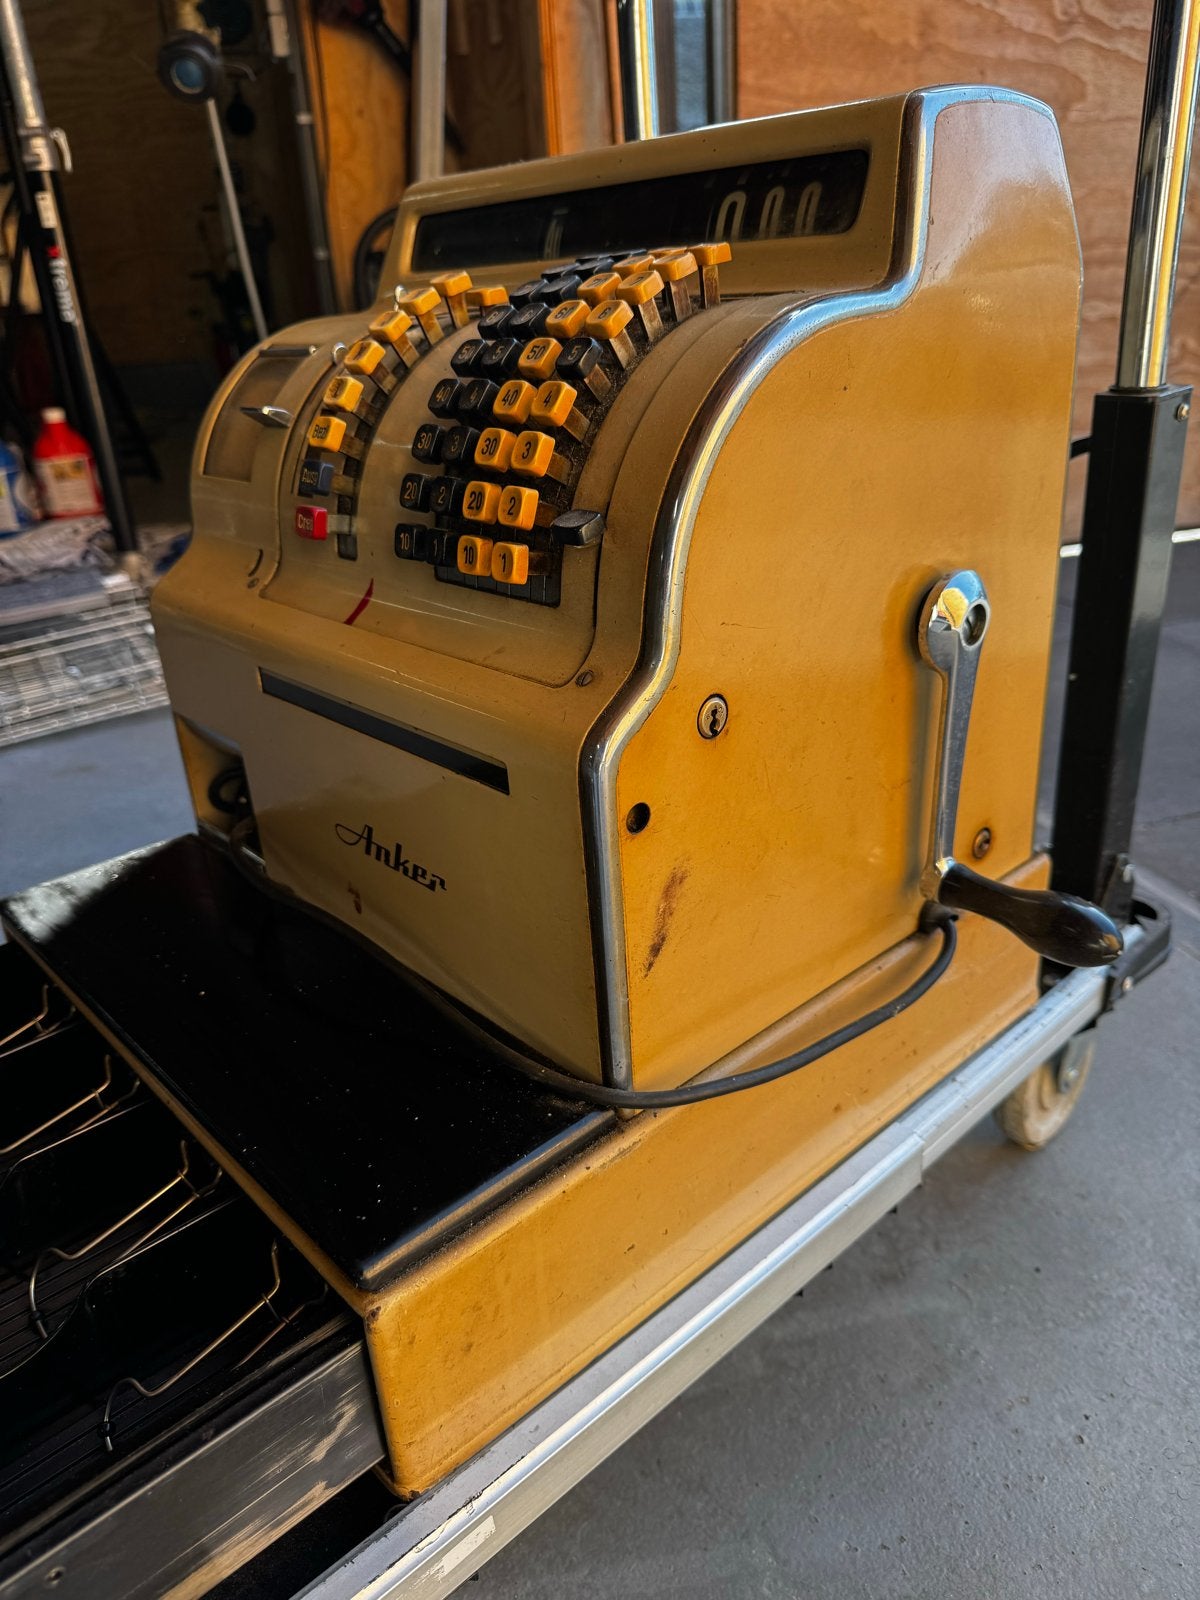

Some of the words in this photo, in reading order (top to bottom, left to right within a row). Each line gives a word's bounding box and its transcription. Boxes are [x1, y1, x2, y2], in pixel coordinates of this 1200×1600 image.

[493, 345, 505, 360] 5
[526, 345, 546, 360] 50
[568, 345, 582, 361] 5
[436, 386, 451, 402] 40
[470, 387, 479, 402] 4
[502, 389, 519, 406] 40
[543, 392, 552, 407] 4
[417, 432, 432, 449] 30
[452, 434, 460, 449] 3
[481, 437, 498, 455] 30
[522, 441, 532, 459] 3
[404, 481, 417, 499] 20
[438, 486, 446, 504] 2
[467, 491, 483, 511] 20
[507, 496, 516, 516] 2
[400, 532, 411, 550] 10
[463, 546, 474, 564] 10
[335, 823, 447, 892] Anker
